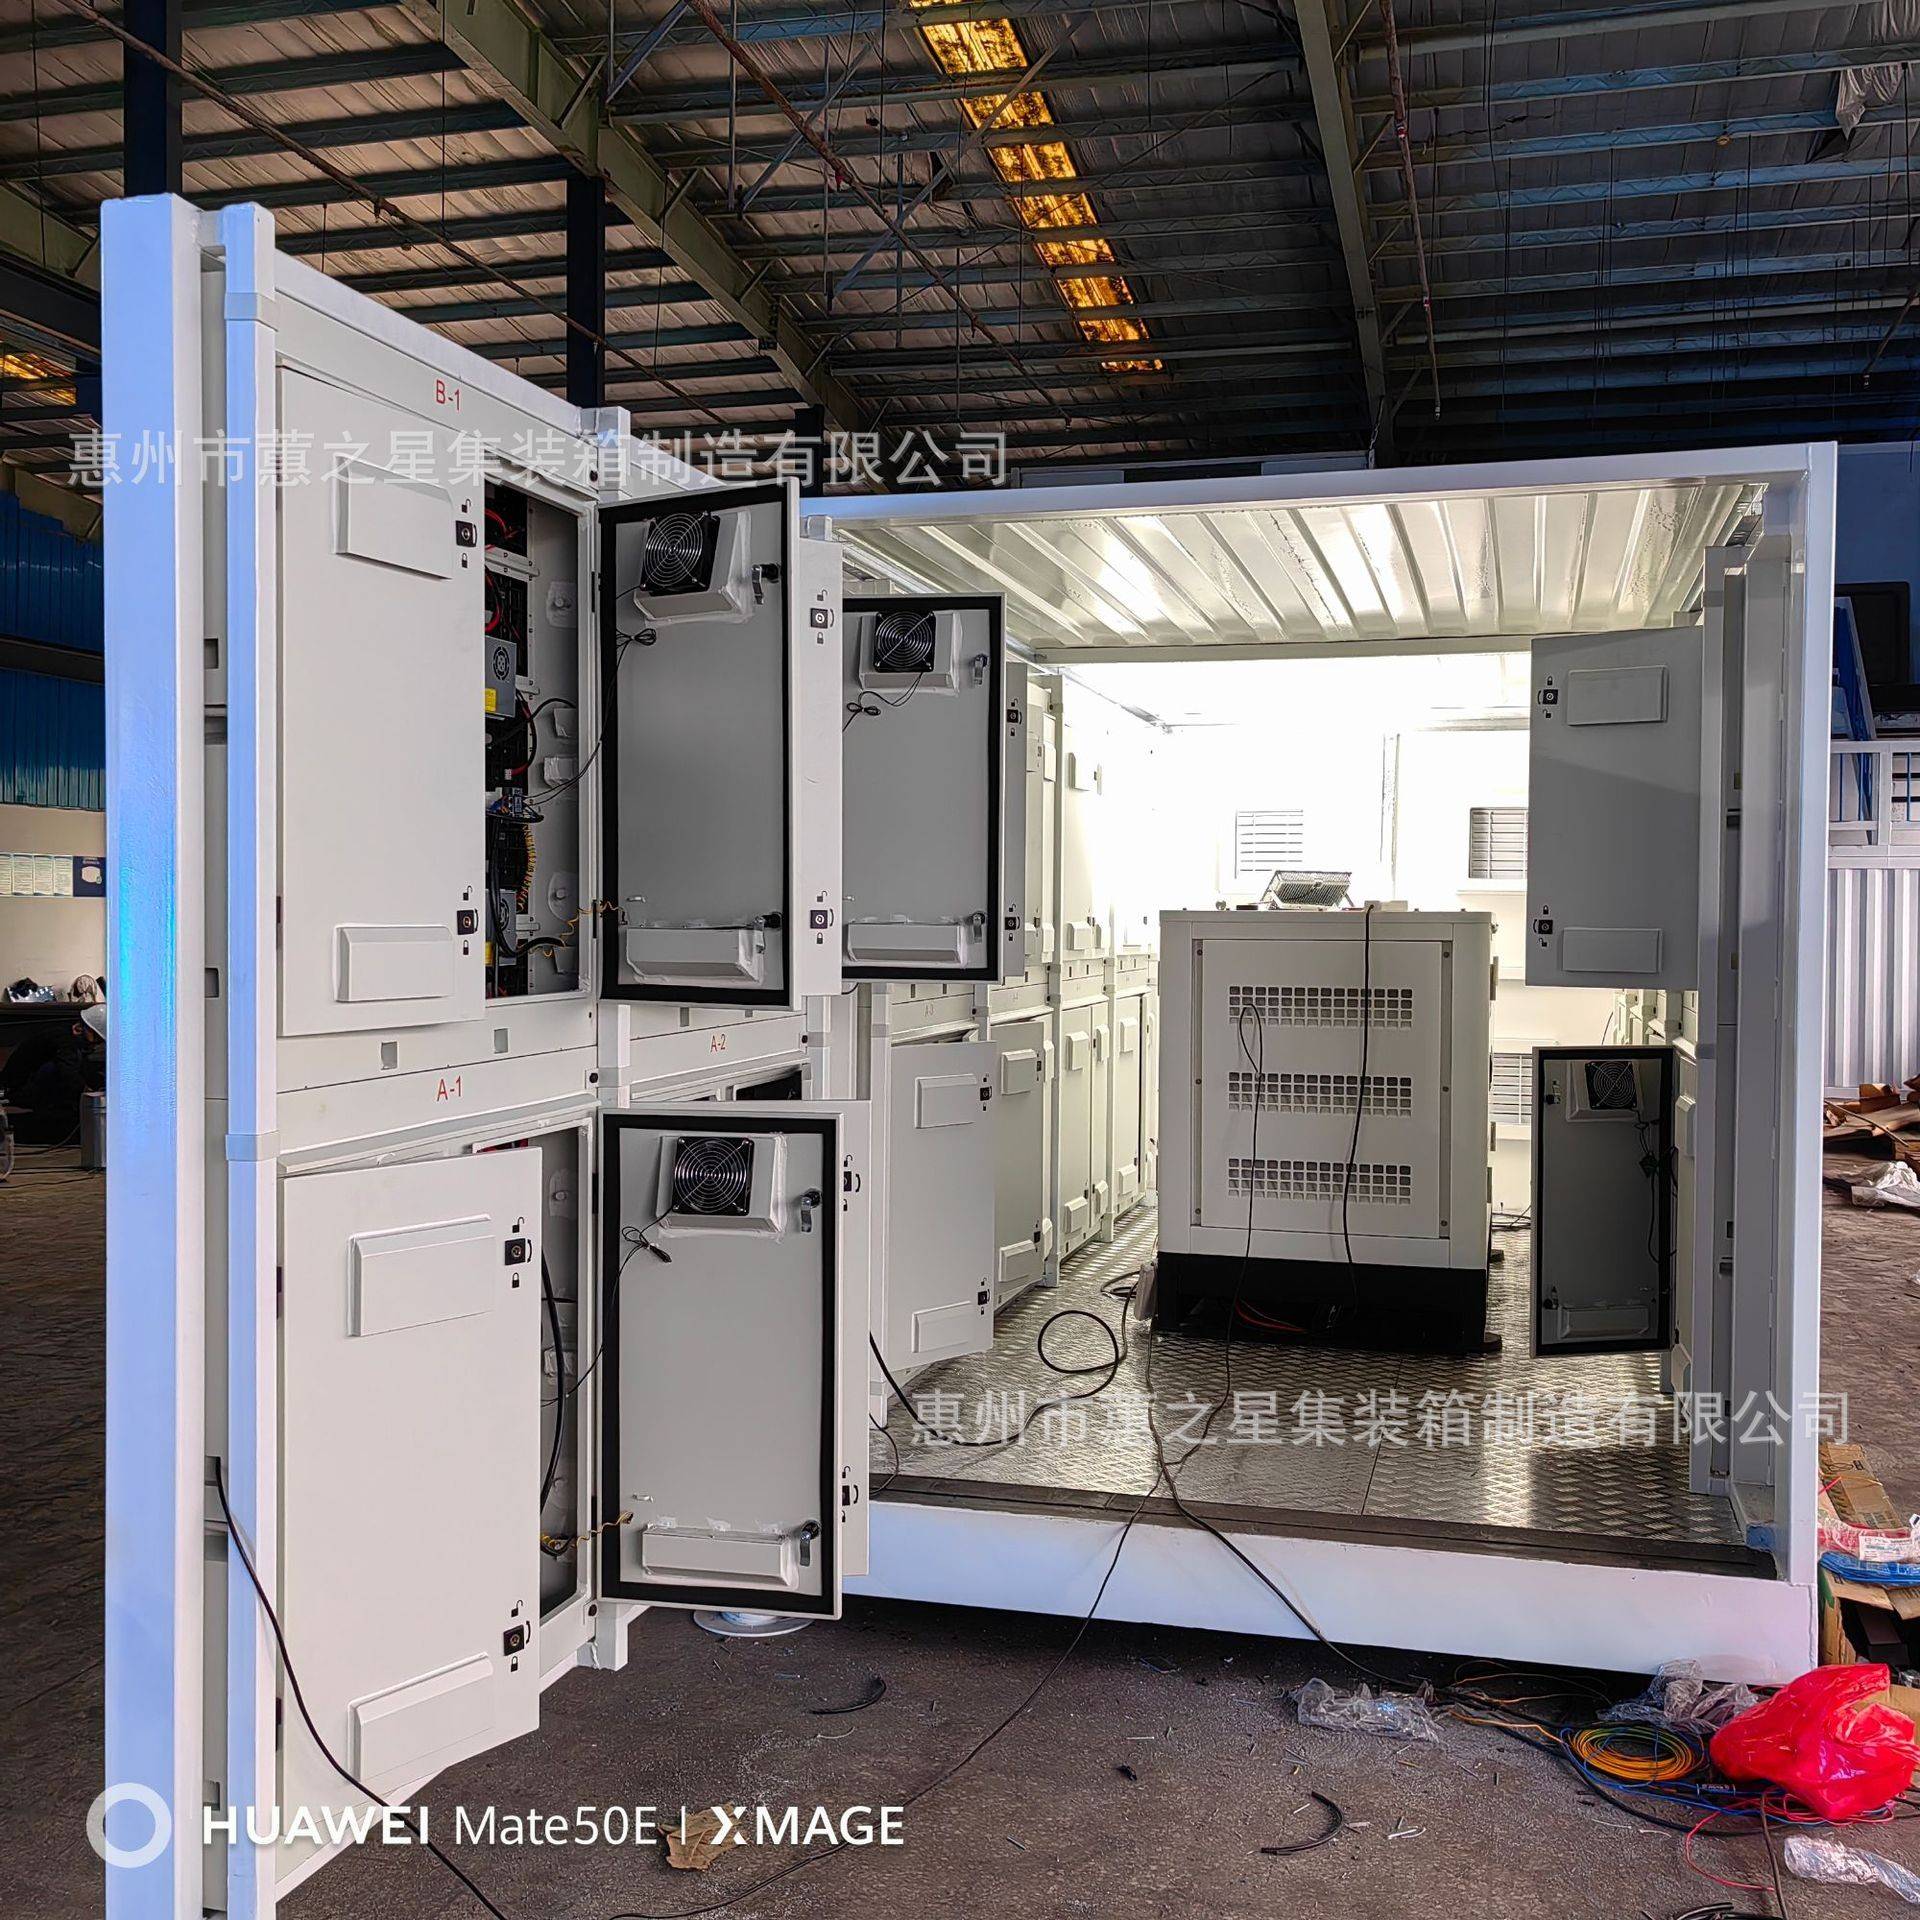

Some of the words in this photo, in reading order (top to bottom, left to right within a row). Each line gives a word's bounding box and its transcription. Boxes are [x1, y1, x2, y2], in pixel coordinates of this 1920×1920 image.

[436, 379, 460, 411] B-1
[710, 1033, 726, 1052] A-2
[436, 1075, 461, 1102] A-1
